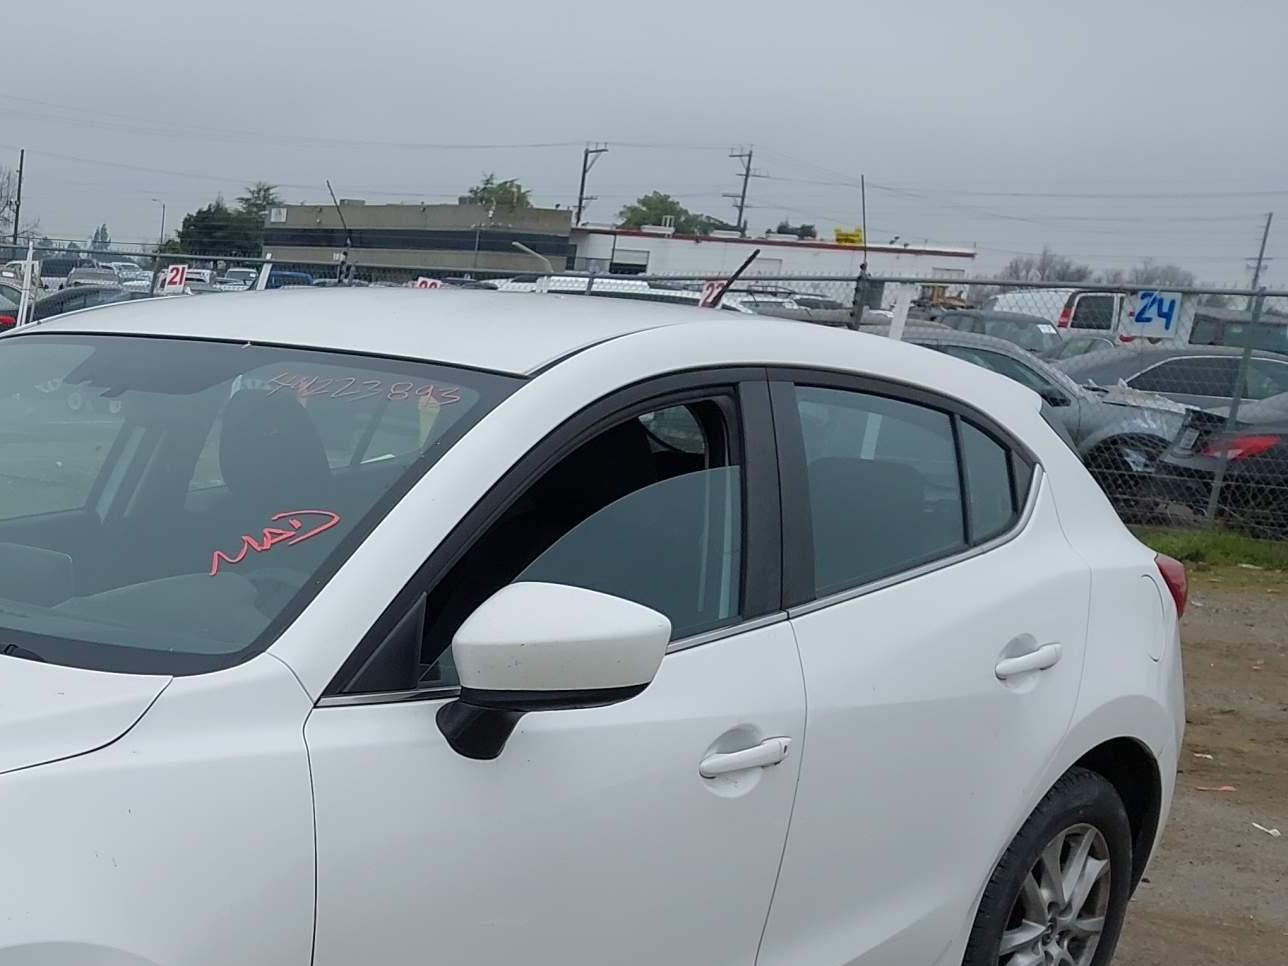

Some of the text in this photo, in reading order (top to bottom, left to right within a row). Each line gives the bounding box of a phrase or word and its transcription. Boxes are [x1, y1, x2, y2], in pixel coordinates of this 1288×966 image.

[167, 266, 186, 286] 21
[1134, 292, 1176, 331] 24
[265, 372, 462, 406] 44223893
